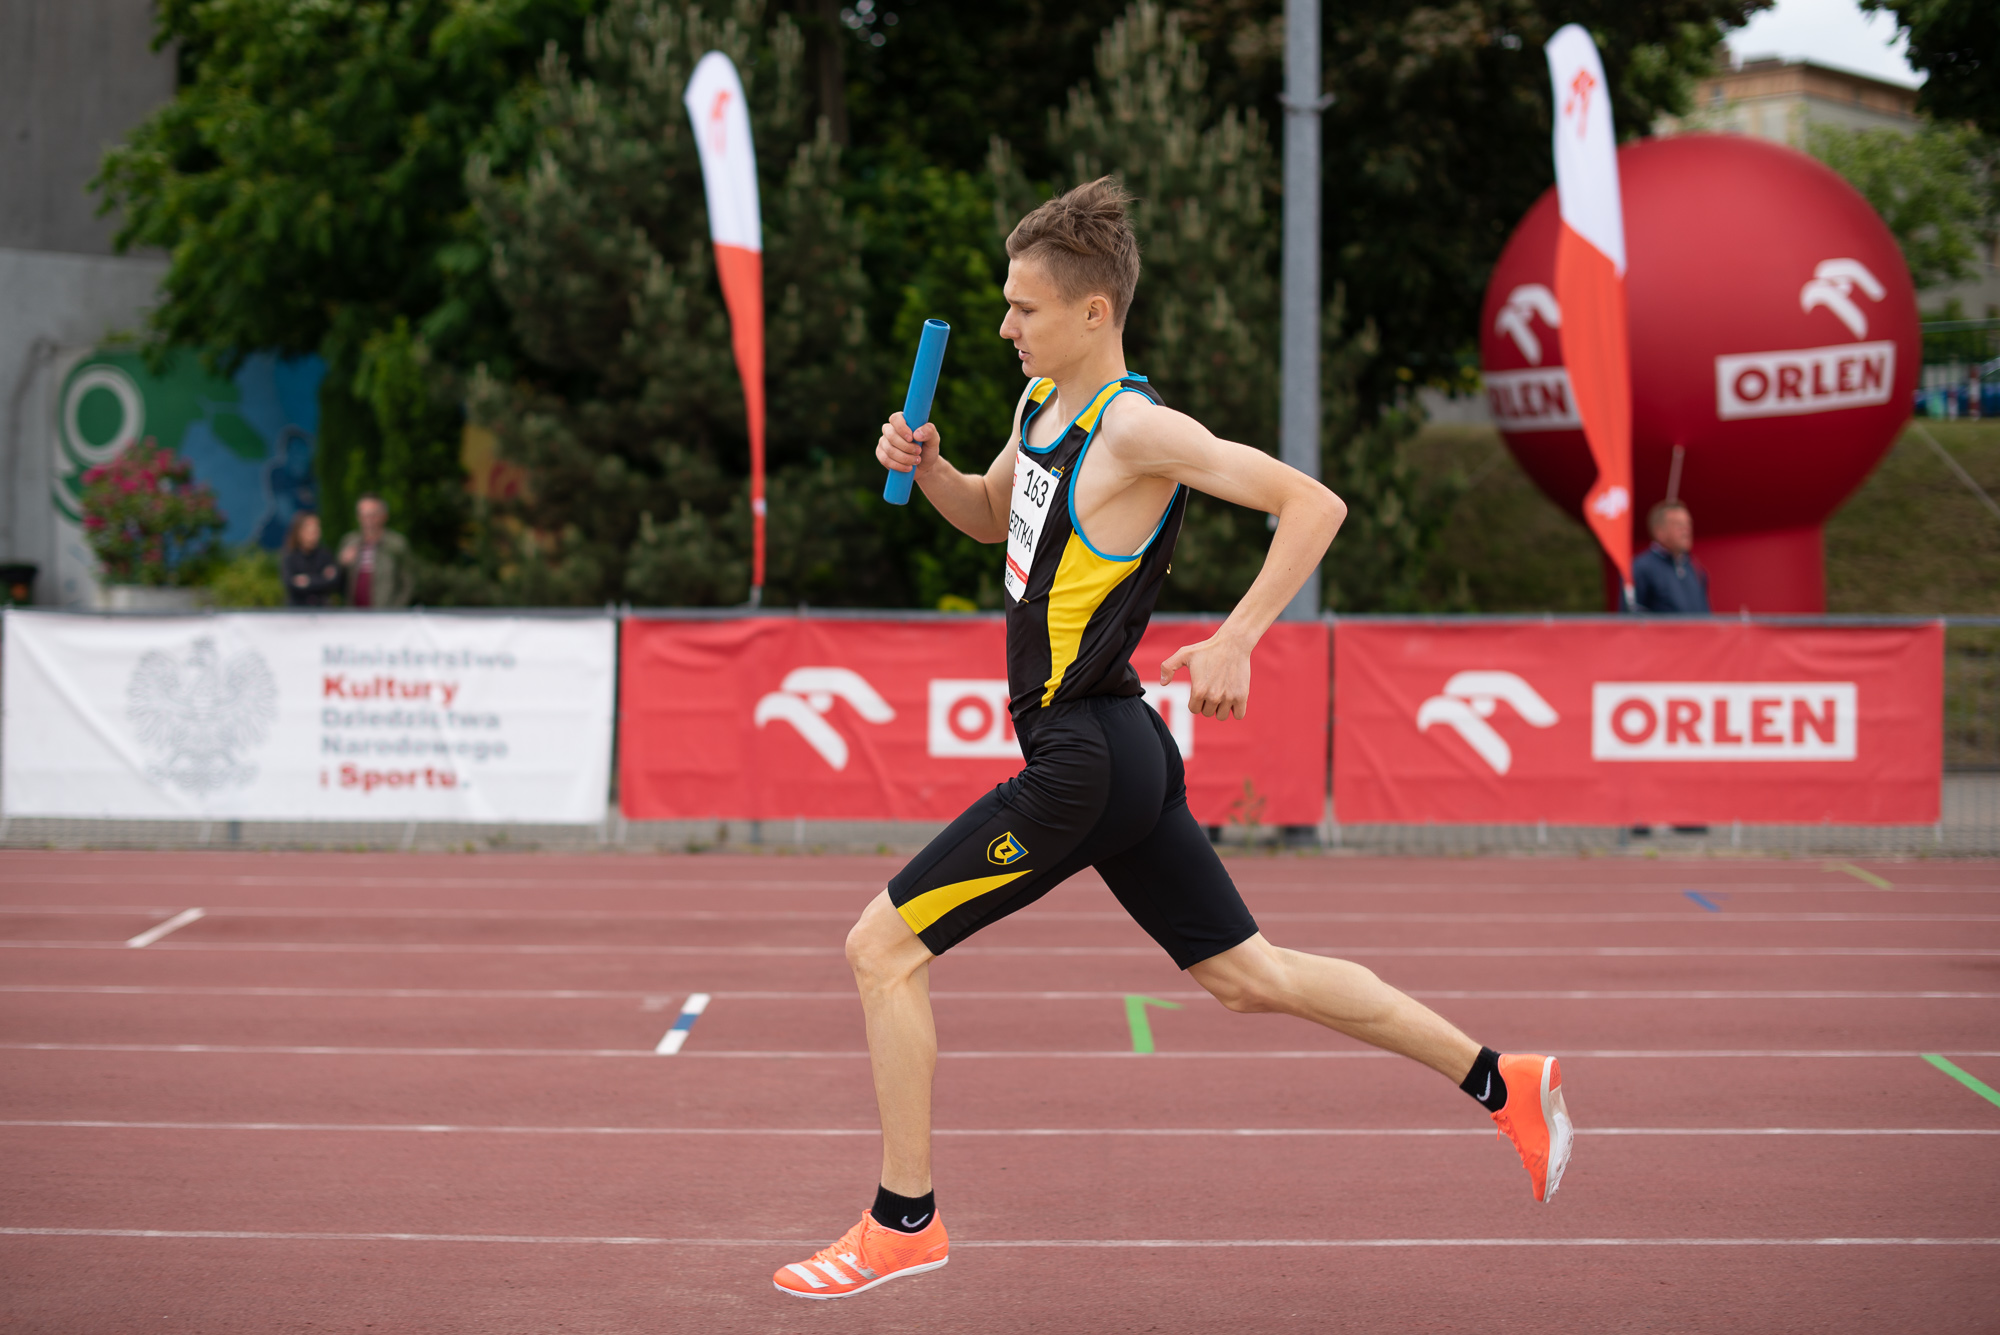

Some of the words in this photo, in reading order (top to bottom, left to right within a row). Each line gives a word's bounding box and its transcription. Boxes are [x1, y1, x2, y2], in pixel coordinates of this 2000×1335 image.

[1733, 354, 1886, 404] ORLEN
[1024, 469, 1049, 508] 163
[321, 645, 515, 669] Ministerstwo
[322, 673, 459, 709] Kultury
[1610, 697, 1837, 745] ORLEN
[321, 736, 508, 763] Narodowego
[320, 769, 329, 787] i
